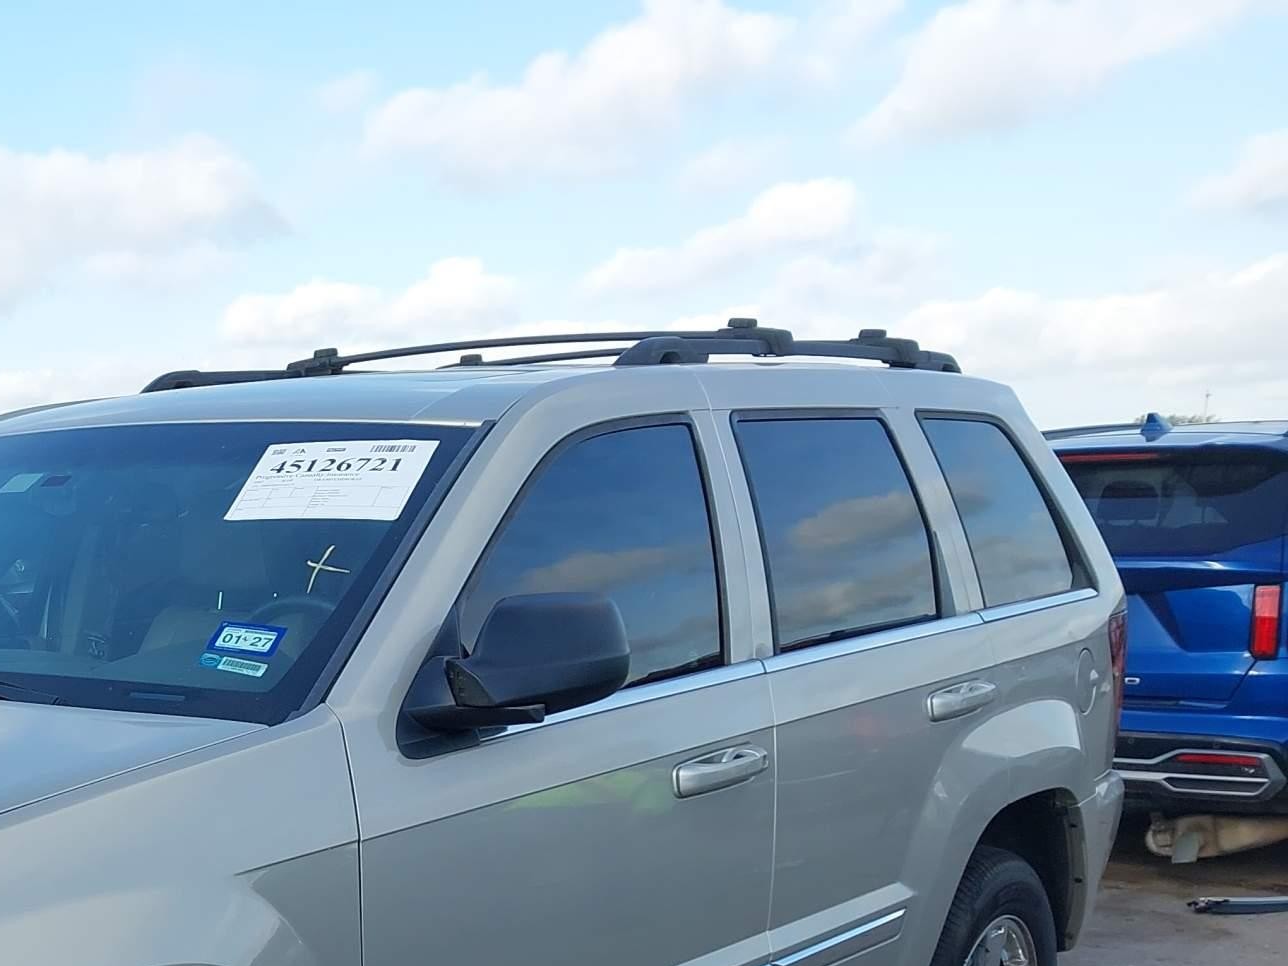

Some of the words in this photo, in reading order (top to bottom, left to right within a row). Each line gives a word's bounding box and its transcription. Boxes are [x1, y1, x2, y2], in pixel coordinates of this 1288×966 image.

[270, 457, 402, 474] 45126721
[222, 633, 242, 645] 01
[249, 636, 273, 648] 27
